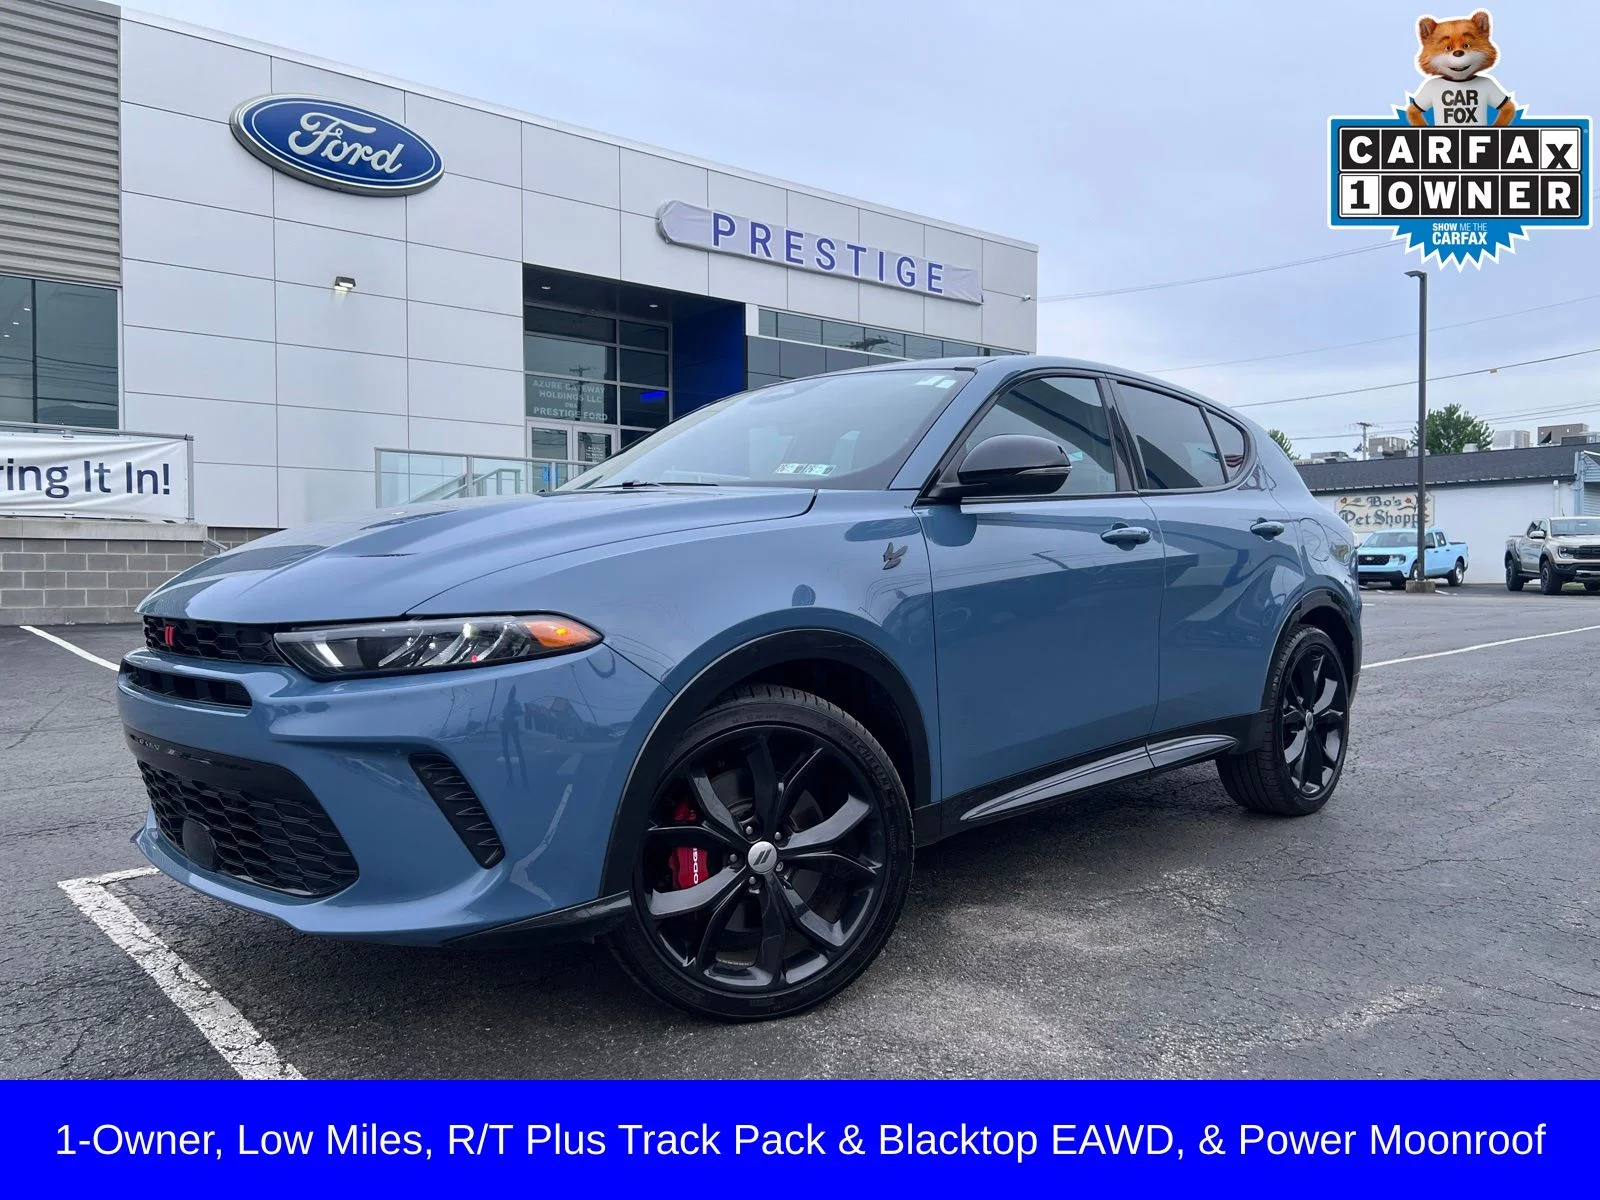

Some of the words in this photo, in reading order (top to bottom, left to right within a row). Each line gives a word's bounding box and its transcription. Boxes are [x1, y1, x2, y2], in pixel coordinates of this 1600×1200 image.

[288, 112, 404, 174] Ford
[711, 211, 945, 296] PRESTIGE
[533, 380, 562, 389] AZURE
[540, 390, 584, 401] HOLDINGS
[586, 395, 602, 403] LLC
[534, 407, 580, 417] PRESTIGE
[584, 412, 608, 420] FORD
[0, 458, 70, 498] ing
[83, 460, 112, 494] It
[125, 461, 171, 495] In!
[1366, 495, 1402, 507] Bo's
[1338, 509, 1372, 526] Pet
